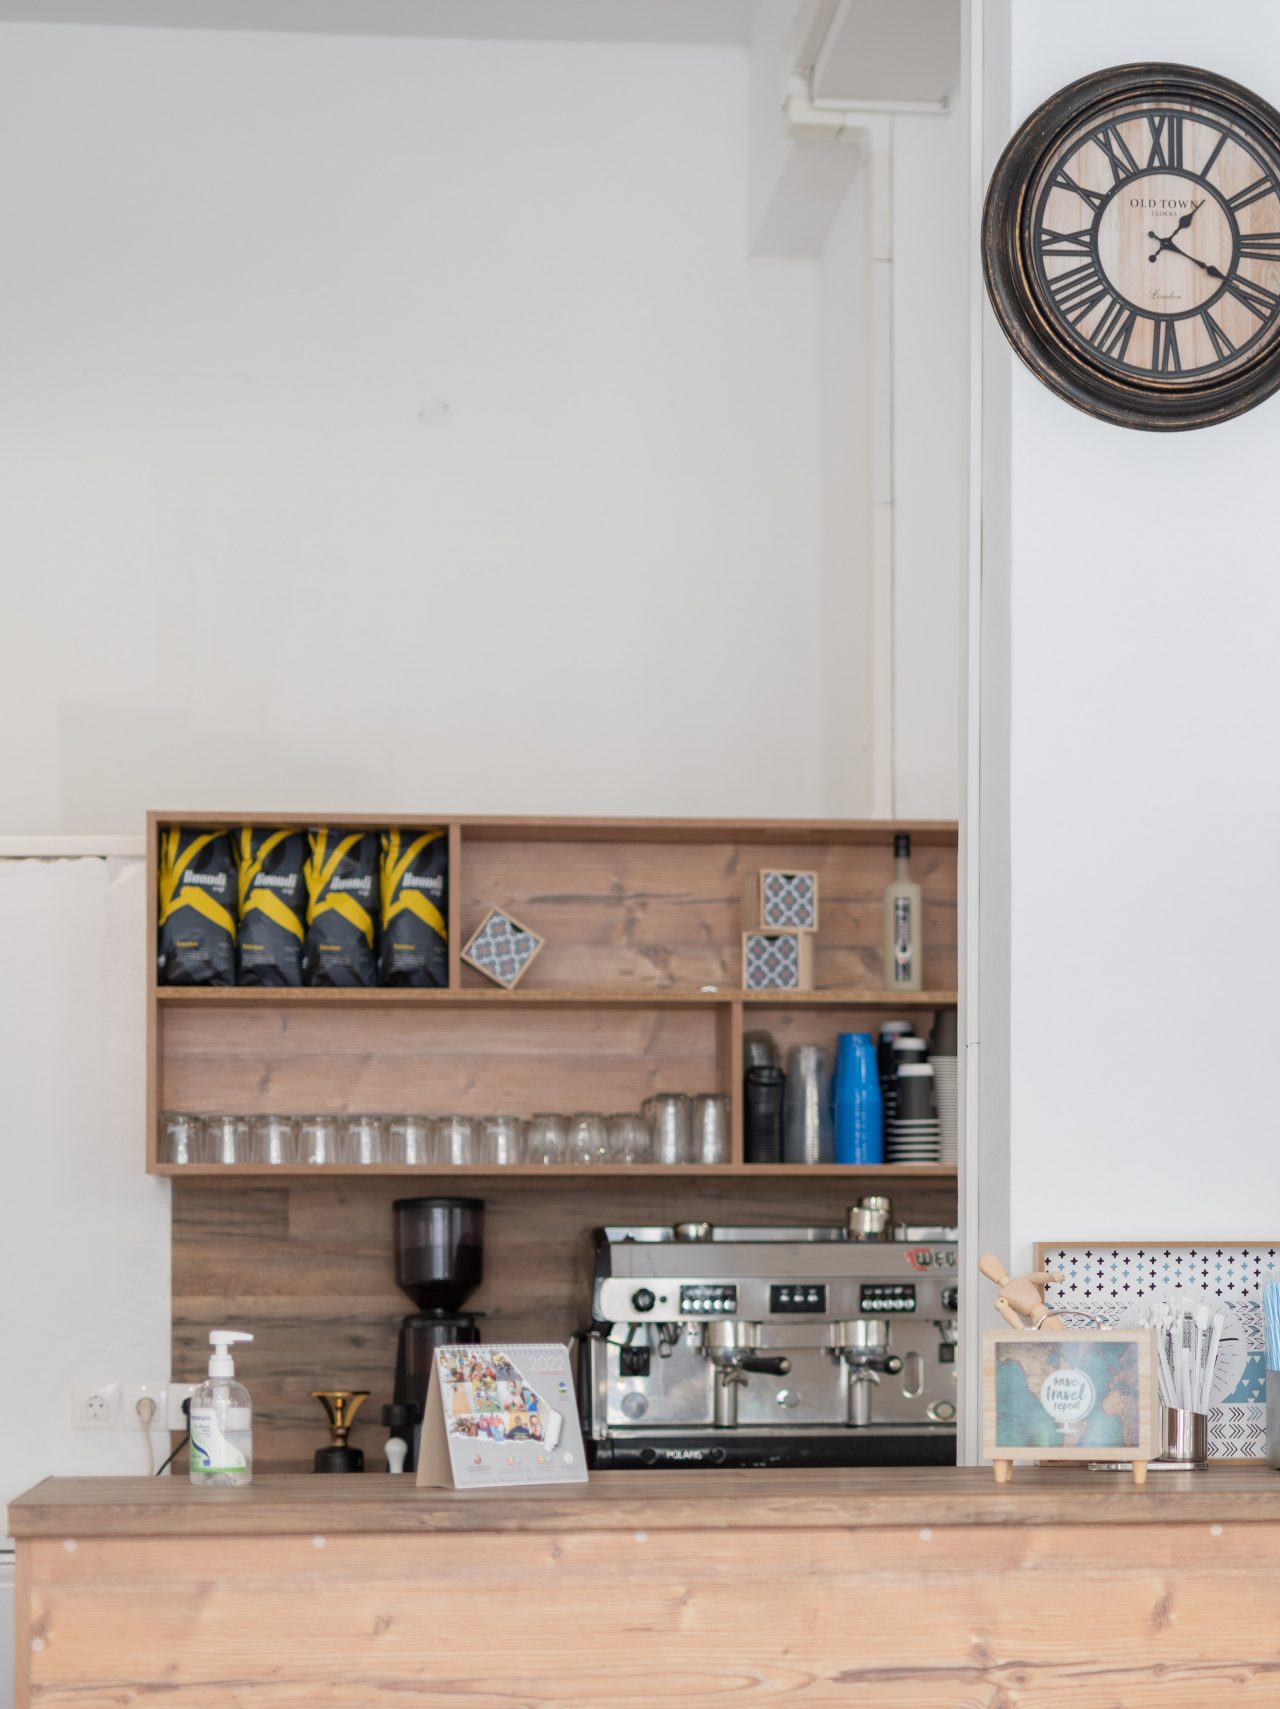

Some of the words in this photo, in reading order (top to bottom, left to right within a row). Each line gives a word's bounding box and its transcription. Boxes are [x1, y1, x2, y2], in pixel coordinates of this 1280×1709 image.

[1147, 114, 1183, 169] XII
[1091, 125, 1139, 184] XI
[1130, 198, 1156, 208] OLD
[1159, 198, 1199, 209] TOWN
[1149, 288, 1182, 300] London
[529, 1356, 566, 1372] 2022
[1046, 1383, 1086, 1402] travel
[1053, 1399, 1080, 1413] repeat
[665, 1448, 703, 1460] POLARIS
